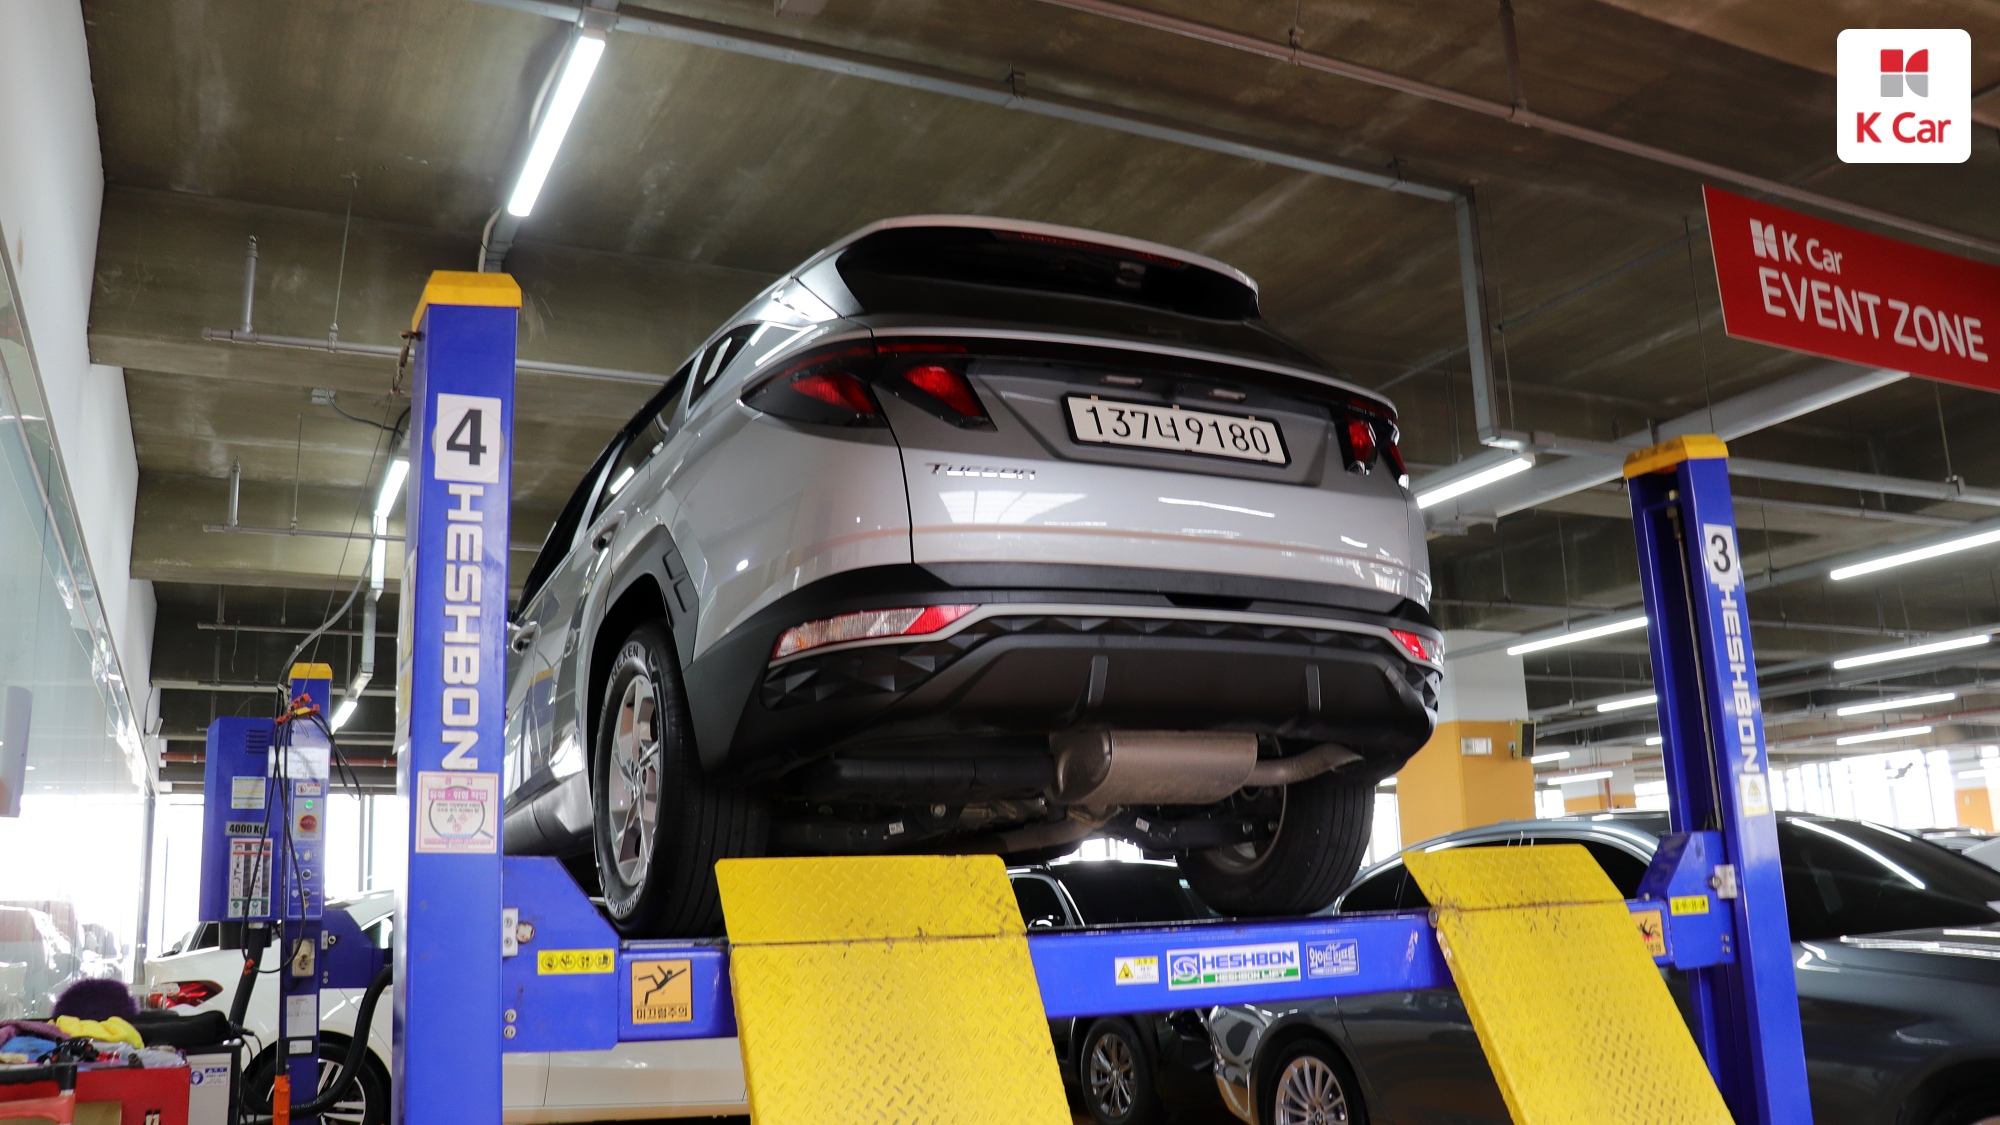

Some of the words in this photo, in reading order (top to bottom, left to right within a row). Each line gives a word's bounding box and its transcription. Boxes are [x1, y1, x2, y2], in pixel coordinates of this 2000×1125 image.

[1782, 230, 1802, 265] K
[1806, 238, 1842, 274] Car
[1759, 266, 1880, 339] EVENT
[1888, 298, 1988, 363] ZONE
[446, 408, 487, 466] 4
[1711, 534, 1731, 573] 3
[441, 483, 484, 771] HESHBON
[611, 644, 639, 684] NEXEN
[1718, 582, 1760, 774] HESHBON
[229, 823, 252, 834] 4000
[1202, 950, 1295, 970] HESHBON
